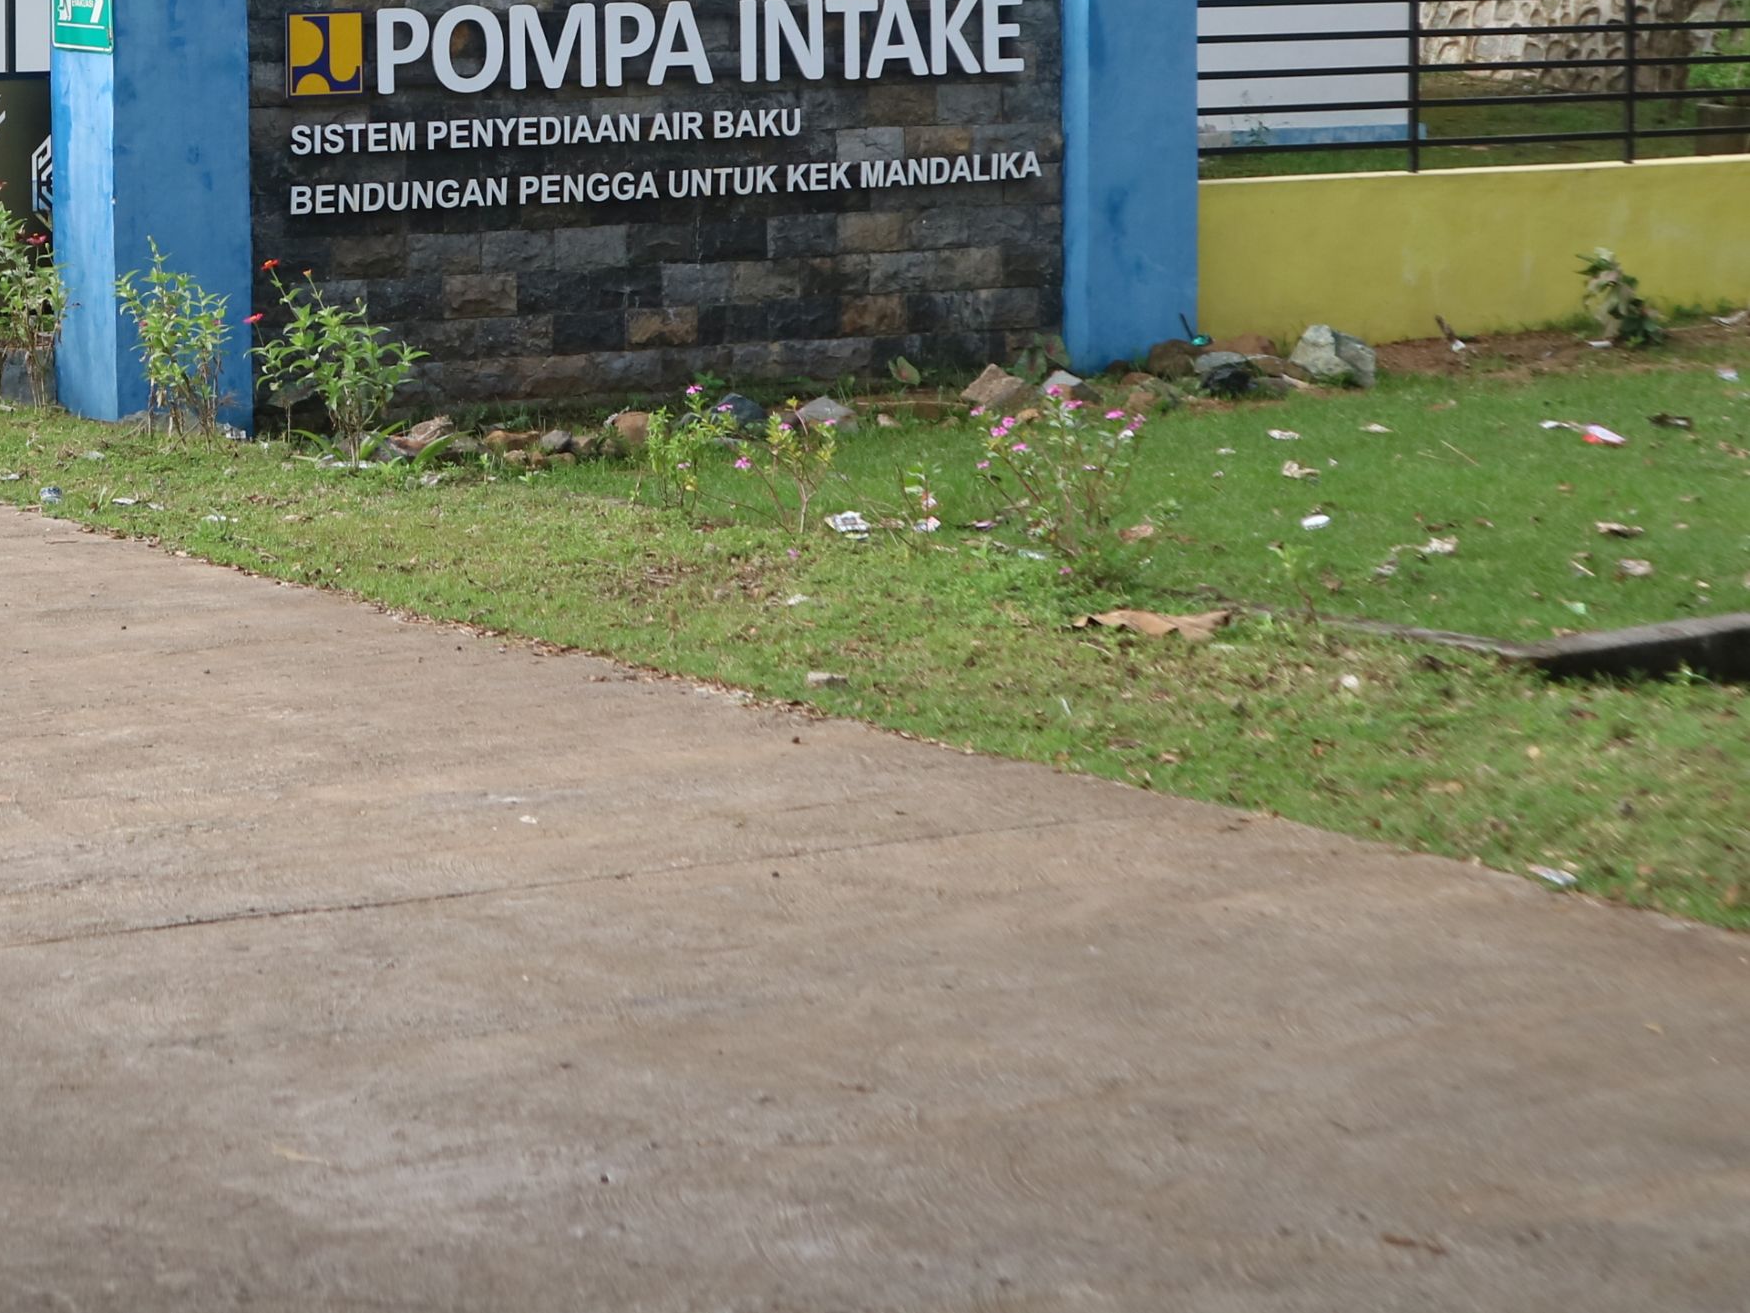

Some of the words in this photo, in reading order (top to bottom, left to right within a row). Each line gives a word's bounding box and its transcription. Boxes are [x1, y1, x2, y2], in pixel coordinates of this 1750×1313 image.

[376, 0, 714, 95] POMPA
[290, 121, 416, 155] SISTEM
[427, 113, 640, 150] PENYEDIAAN
[649, 111, 704, 141] AIR
[713, 108, 802, 139] BAKU
[290, 177, 508, 215] BENDUNGAN
[519, 171, 660, 204] PENGGA
[668, 165, 778, 199] UNTUK
[786, 161, 852, 192] KEK
[860, 151, 1042, 189] MANDALIKA
